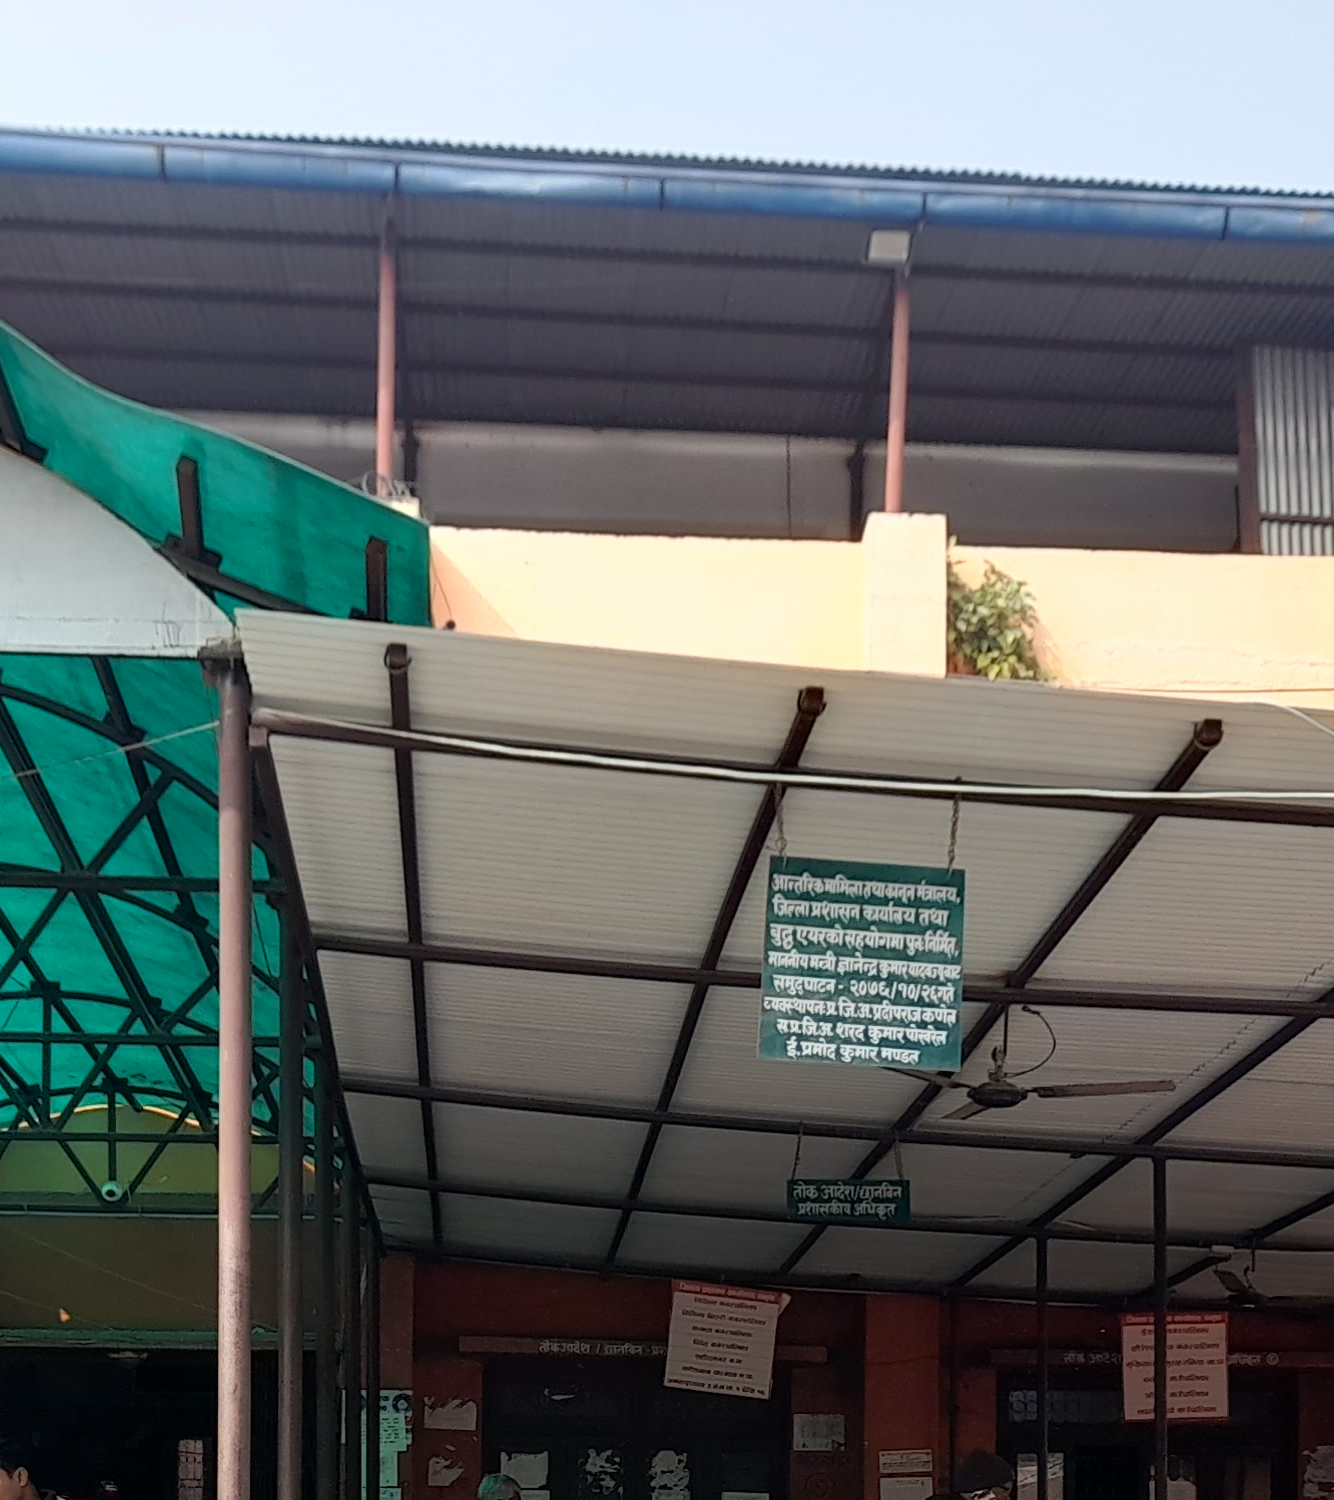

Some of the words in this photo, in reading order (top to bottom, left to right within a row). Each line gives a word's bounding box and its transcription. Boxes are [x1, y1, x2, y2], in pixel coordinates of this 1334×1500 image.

[771, 872, 824, 897] आन्तरिक
[863, 881, 884, 900] तथा
[772, 893, 809, 916] जिल्ला
[810, 901, 860, 924] प्रशासन
[863, 900, 916, 924] कार्यालय
[918, 908, 950, 928] तथा
[844, 926, 904, 951] सहयोगमा
[767, 949, 809, 969] माननीय
[878, 960, 908, 979] कुमार
[835, 1022, 866, 1042] शरद
[868, 1025, 904, 1044] कुमार
[840, 1044, 878, 1063] कुमार
[880, 1046, 921, 1065] मण्डल
